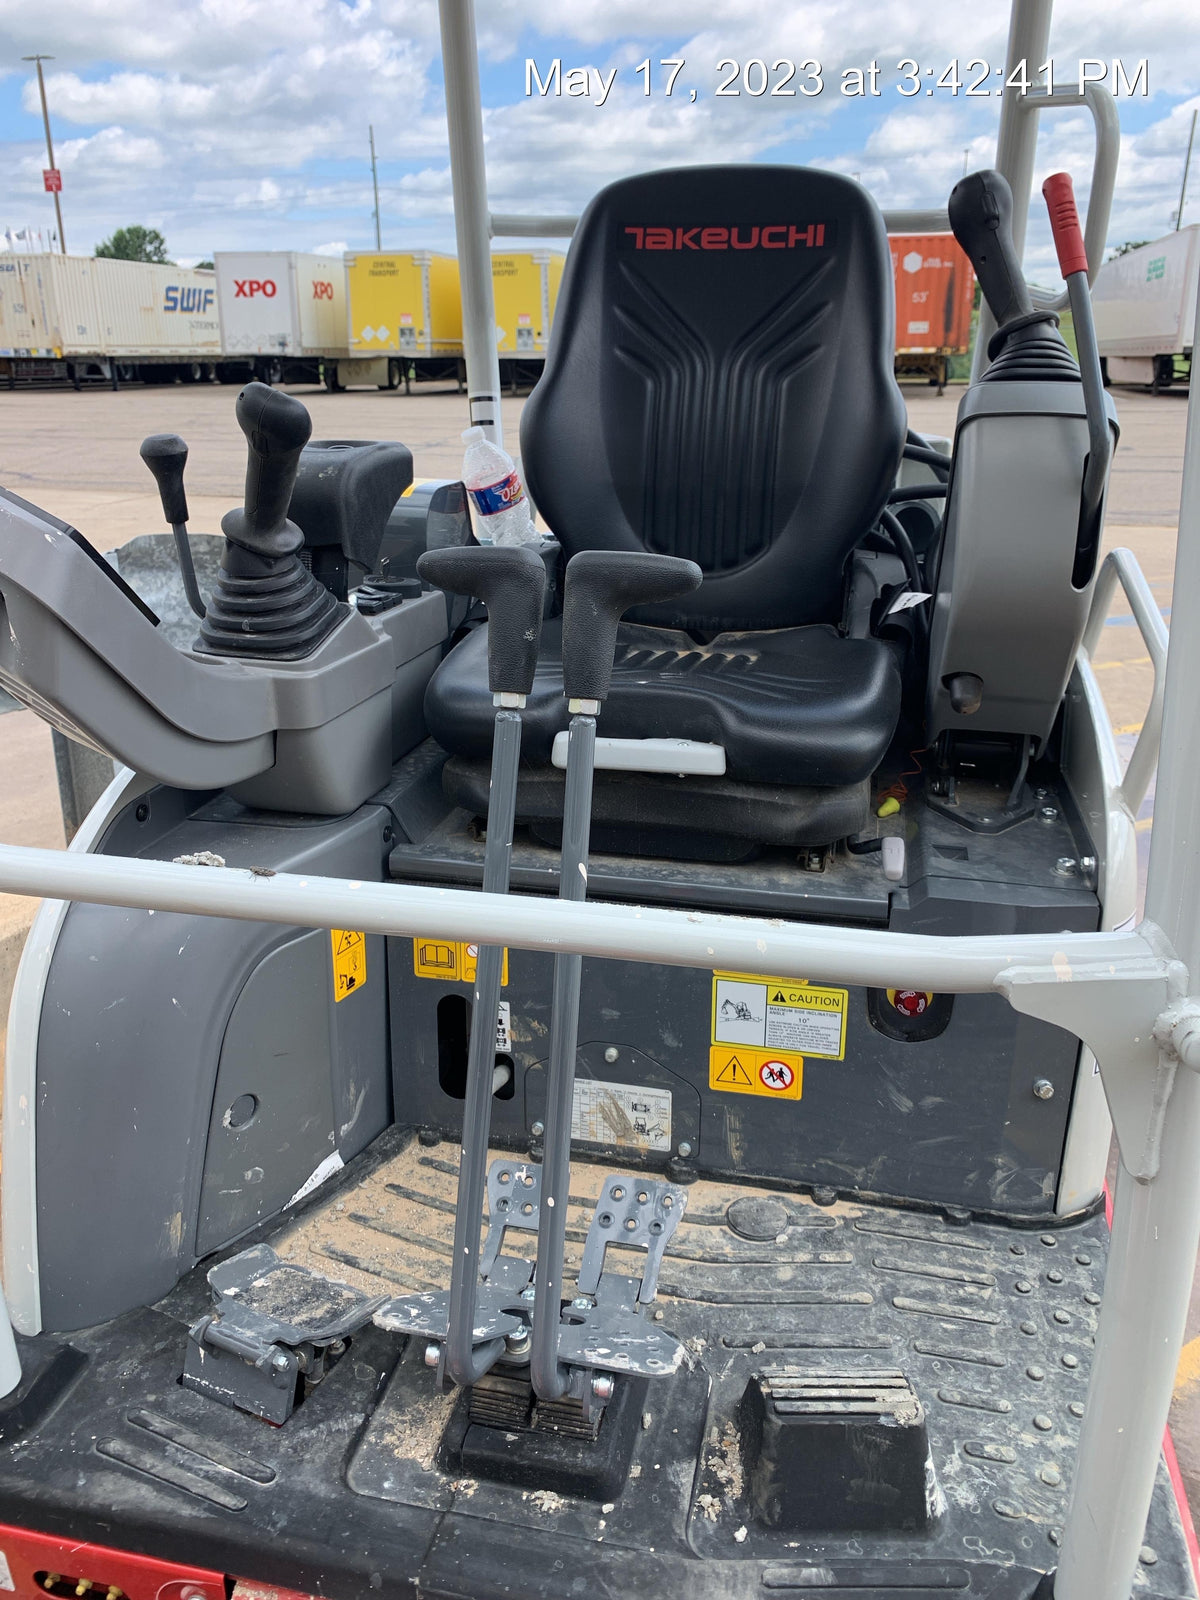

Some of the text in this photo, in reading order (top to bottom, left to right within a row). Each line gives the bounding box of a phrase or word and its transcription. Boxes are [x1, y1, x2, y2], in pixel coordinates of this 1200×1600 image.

[233, 279, 277, 298] XPO
[312, 280, 334, 300] XPO
[163, 285, 214, 313] SWIF
[789, 993, 840, 1007] CAUTION
[806, 1010, 838, 1018] INCLINATION
